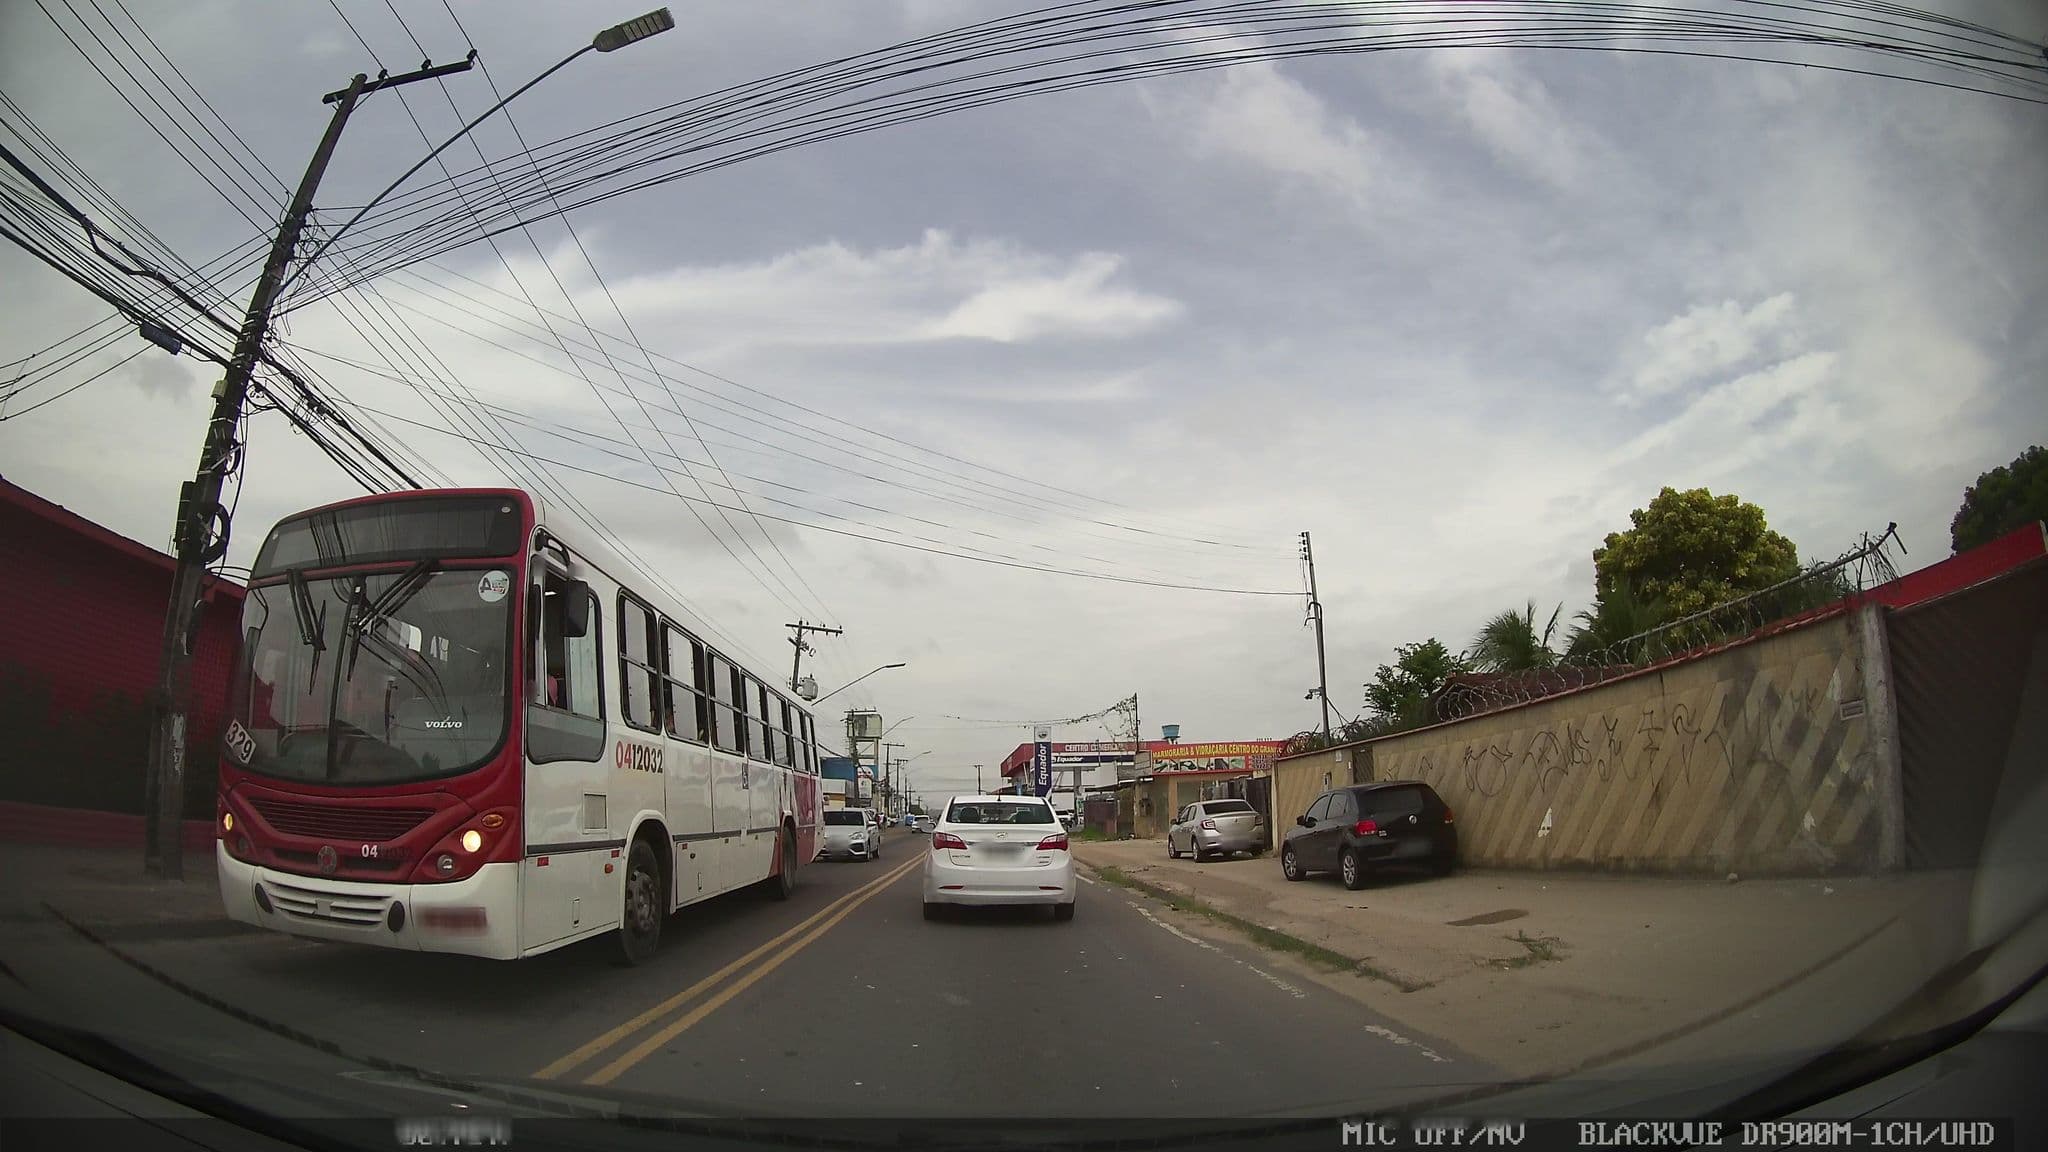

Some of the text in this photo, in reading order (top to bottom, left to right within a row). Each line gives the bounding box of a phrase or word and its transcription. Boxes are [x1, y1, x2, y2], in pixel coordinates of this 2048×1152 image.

[424, 716, 463, 729] VOLVO
[226, 723, 255, 761] 329
[1065, 743, 1089, 752] CENTRO
[615, 740, 664, 774] 0412032
[1196, 744, 1228, 757] VIDRAÇARIA
[1229, 744, 1250, 754] CENTRO
[1251, 744, 1260, 754] DO
[1038, 743, 1049, 785] Equador
[1057, 756, 1084, 764] Equador
